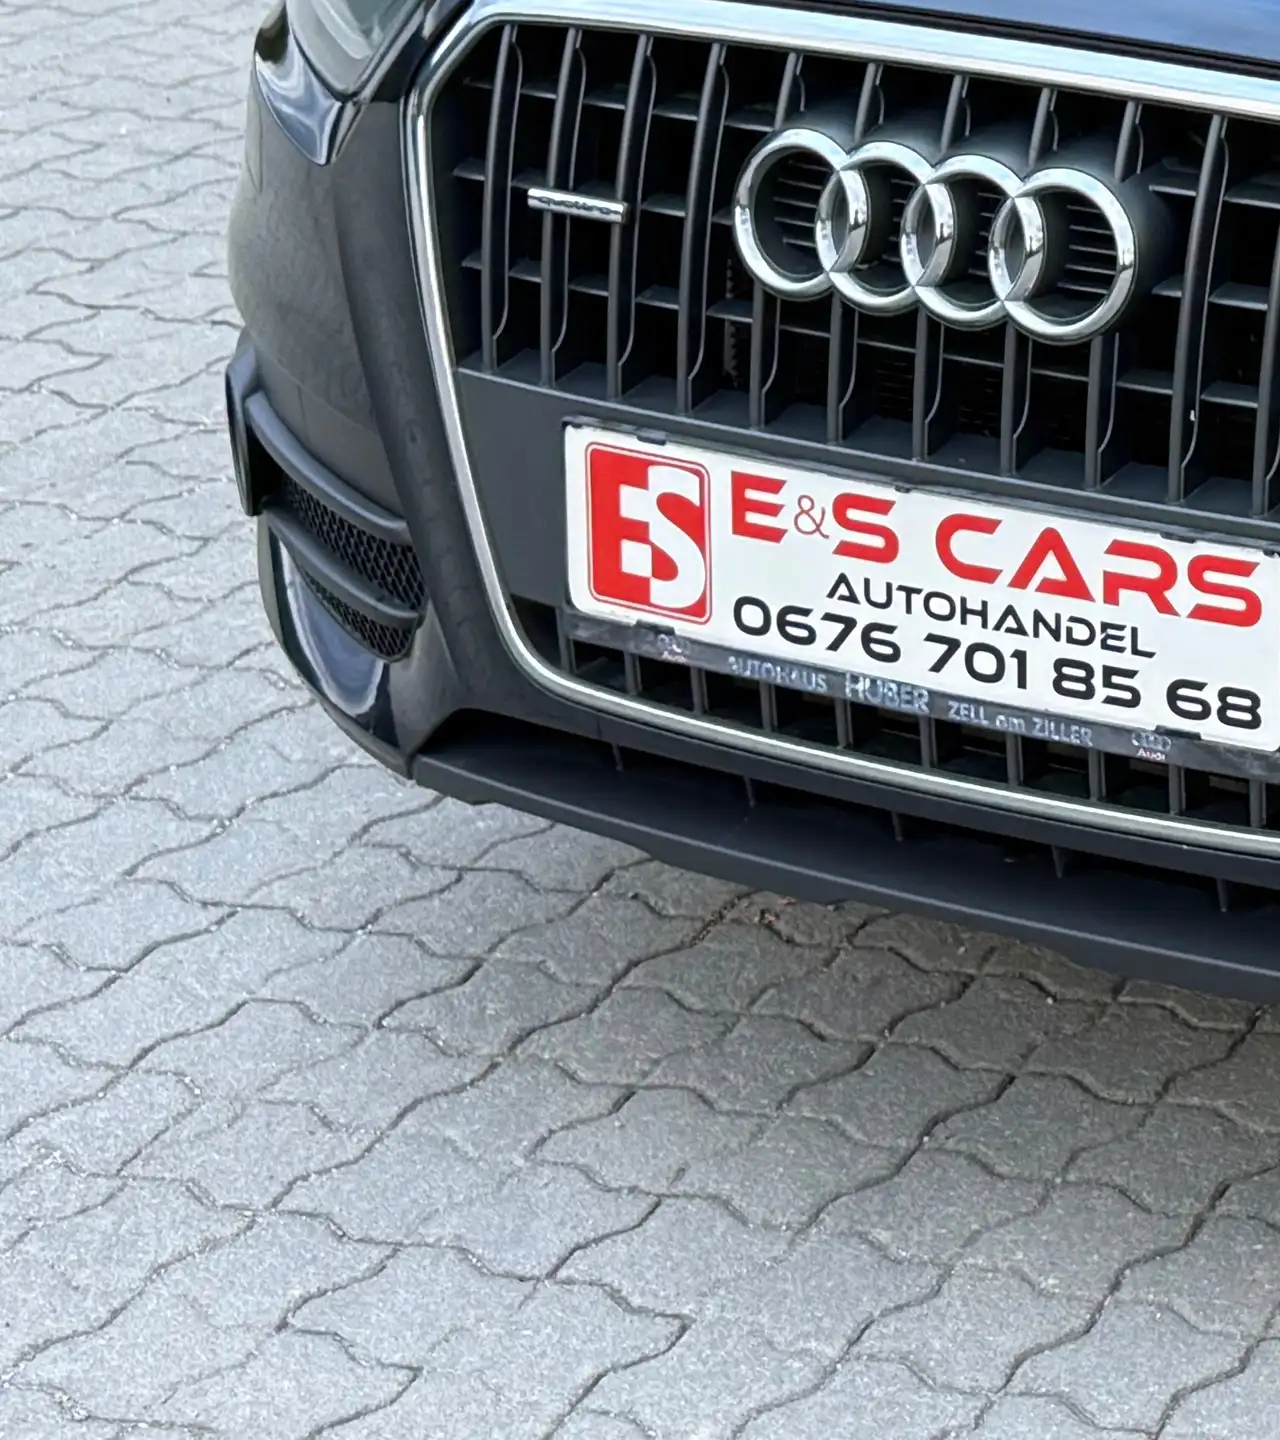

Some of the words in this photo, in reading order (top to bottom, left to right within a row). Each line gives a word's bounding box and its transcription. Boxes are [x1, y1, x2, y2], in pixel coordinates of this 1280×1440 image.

[731, 470, 900, 564] E&S
[935, 513, 1263, 627] CARS
[733, 595, 902, 663] 0676
[923, 632, 1027, 690] 701
[1052, 657, 1142, 709] 85
[1166, 678, 1262, 730] 68
[826, 572, 1157, 659] AUTOHANDEL
[845, 669, 930, 714] HUBER
[947, 700, 989, 724] ZELL
[1032, 717, 1093, 747] ZILLER
